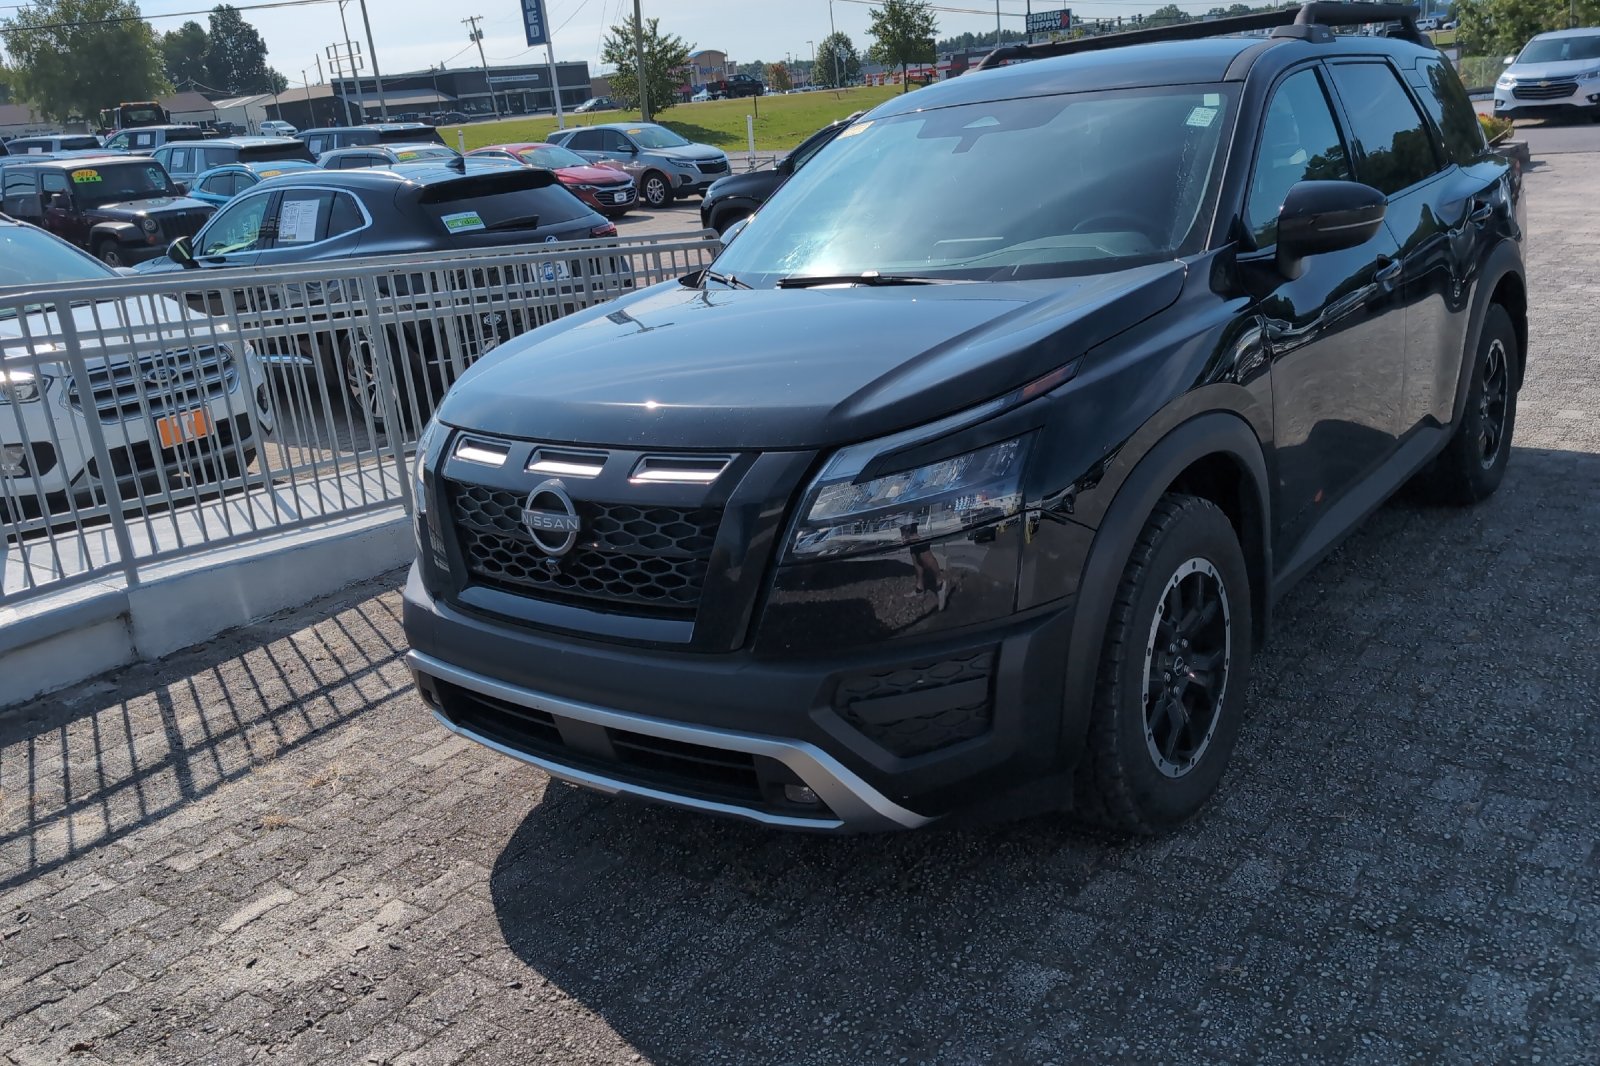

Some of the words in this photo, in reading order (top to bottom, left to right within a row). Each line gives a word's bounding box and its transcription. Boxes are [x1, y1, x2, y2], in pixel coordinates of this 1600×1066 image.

[1027, 11, 1061, 23] SIDING
[1027, 19, 1062, 31] SUPPLY
[521, 511, 578, 530] NISSAN
